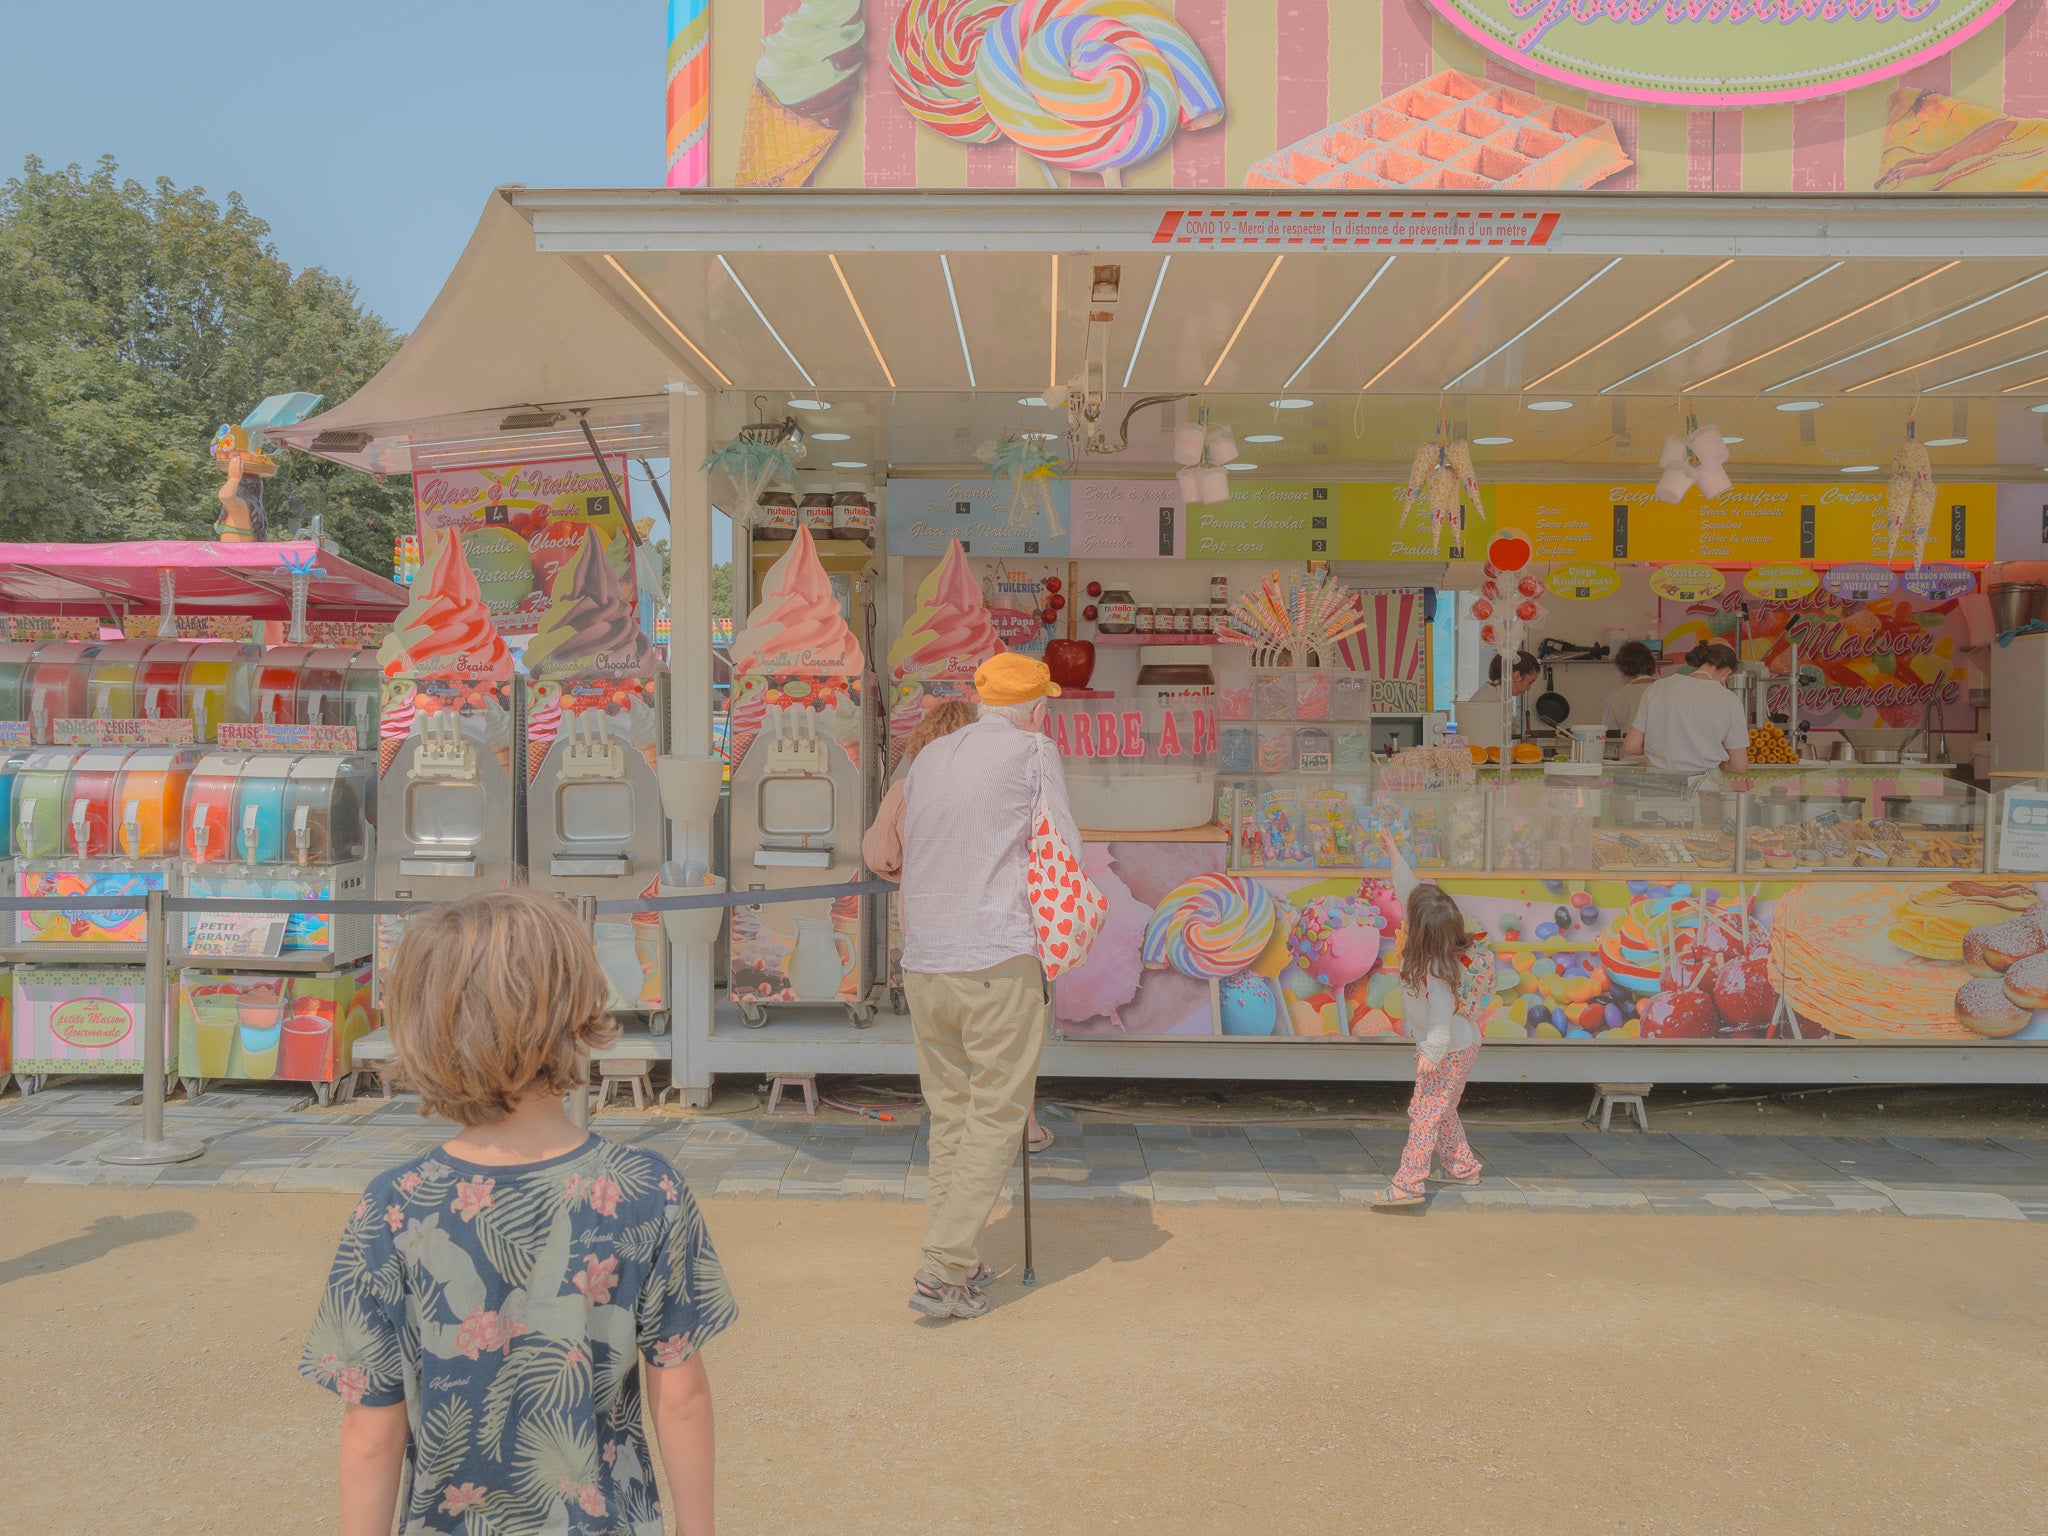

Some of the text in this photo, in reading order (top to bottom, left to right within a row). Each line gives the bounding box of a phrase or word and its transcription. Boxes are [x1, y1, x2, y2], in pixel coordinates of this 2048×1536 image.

[1186, 220, 1527, 238] COVID 19 Merci de respecter la distance de préventn d'un mètre
[421, 478, 480, 515] Glace
[486, 475, 503, 500] à
[1140, 488, 1177, 504] papa
[1608, 486, 1884, 507] Beign Gaufres Crêpes
[540, 504, 579, 518] Double
[594, 498, 603, 511] 6
[1536, 505, 1563, 516] Sucre
[492, 509, 504, 521] 4
[767, 507, 796, 517] nutella
[1162, 511, 1171, 526] 3
[1731, 507, 1742, 517] de
[1200, 514, 1249, 529] Pomme
[1536, 519, 1562, 529] Sucre
[909, 521, 948, 541] Glace
[1536, 532, 1562, 542] Sucre
[1802, 521, 1814, 544] 5
[528, 532, 584, 554] Chocola
[1084, 531, 1133, 553] Grande
[1729, 533, 1740, 543] de
[1007, 568, 1027, 583] FÊTE
[1665, 567, 1712, 578] Gaufres
[1826, 571, 1860, 580] CHURROS
[1904, 572, 1938, 580] CHURROS
[1553, 576, 1613, 586] Kinder maxi
[1843, 582, 1878, 590] NUTELLA
[484, 598, 519, 611] tron,
[1104, 605, 1132, 613] nutella
[16, 618, 53, 631] MENTHE
[175, 618, 208, 630] ALABAR
[1002, 616, 1008, 626] à
[1010, 616, 1035, 628] Papa
[996, 627, 1020, 637] éant
[1788, 619, 1935, 661] Maison
[456, 654, 495, 672] Fraise
[595, 653, 642, 670] Chocolat
[801, 650, 846, 667] Caramel
[947, 656, 984, 673] Framb
[1371, 680, 1418, 713] BONS
[105, 721, 140, 734] CERISE
[222, 726, 260, 739] FRAISE
[266, 726, 308, 735] TROPICAL
[1157, 708, 1183, 757] A
[1191, 706, 1221, 756] PA
[316, 729, 351, 741] COCA
[200, 922, 237, 931] PETIT
[197, 933, 240, 942] GRAND
[194, 943, 221, 951] POT
[87, 1012, 126, 1024] Maison
[63, 1025, 120, 1040] Gourmande
